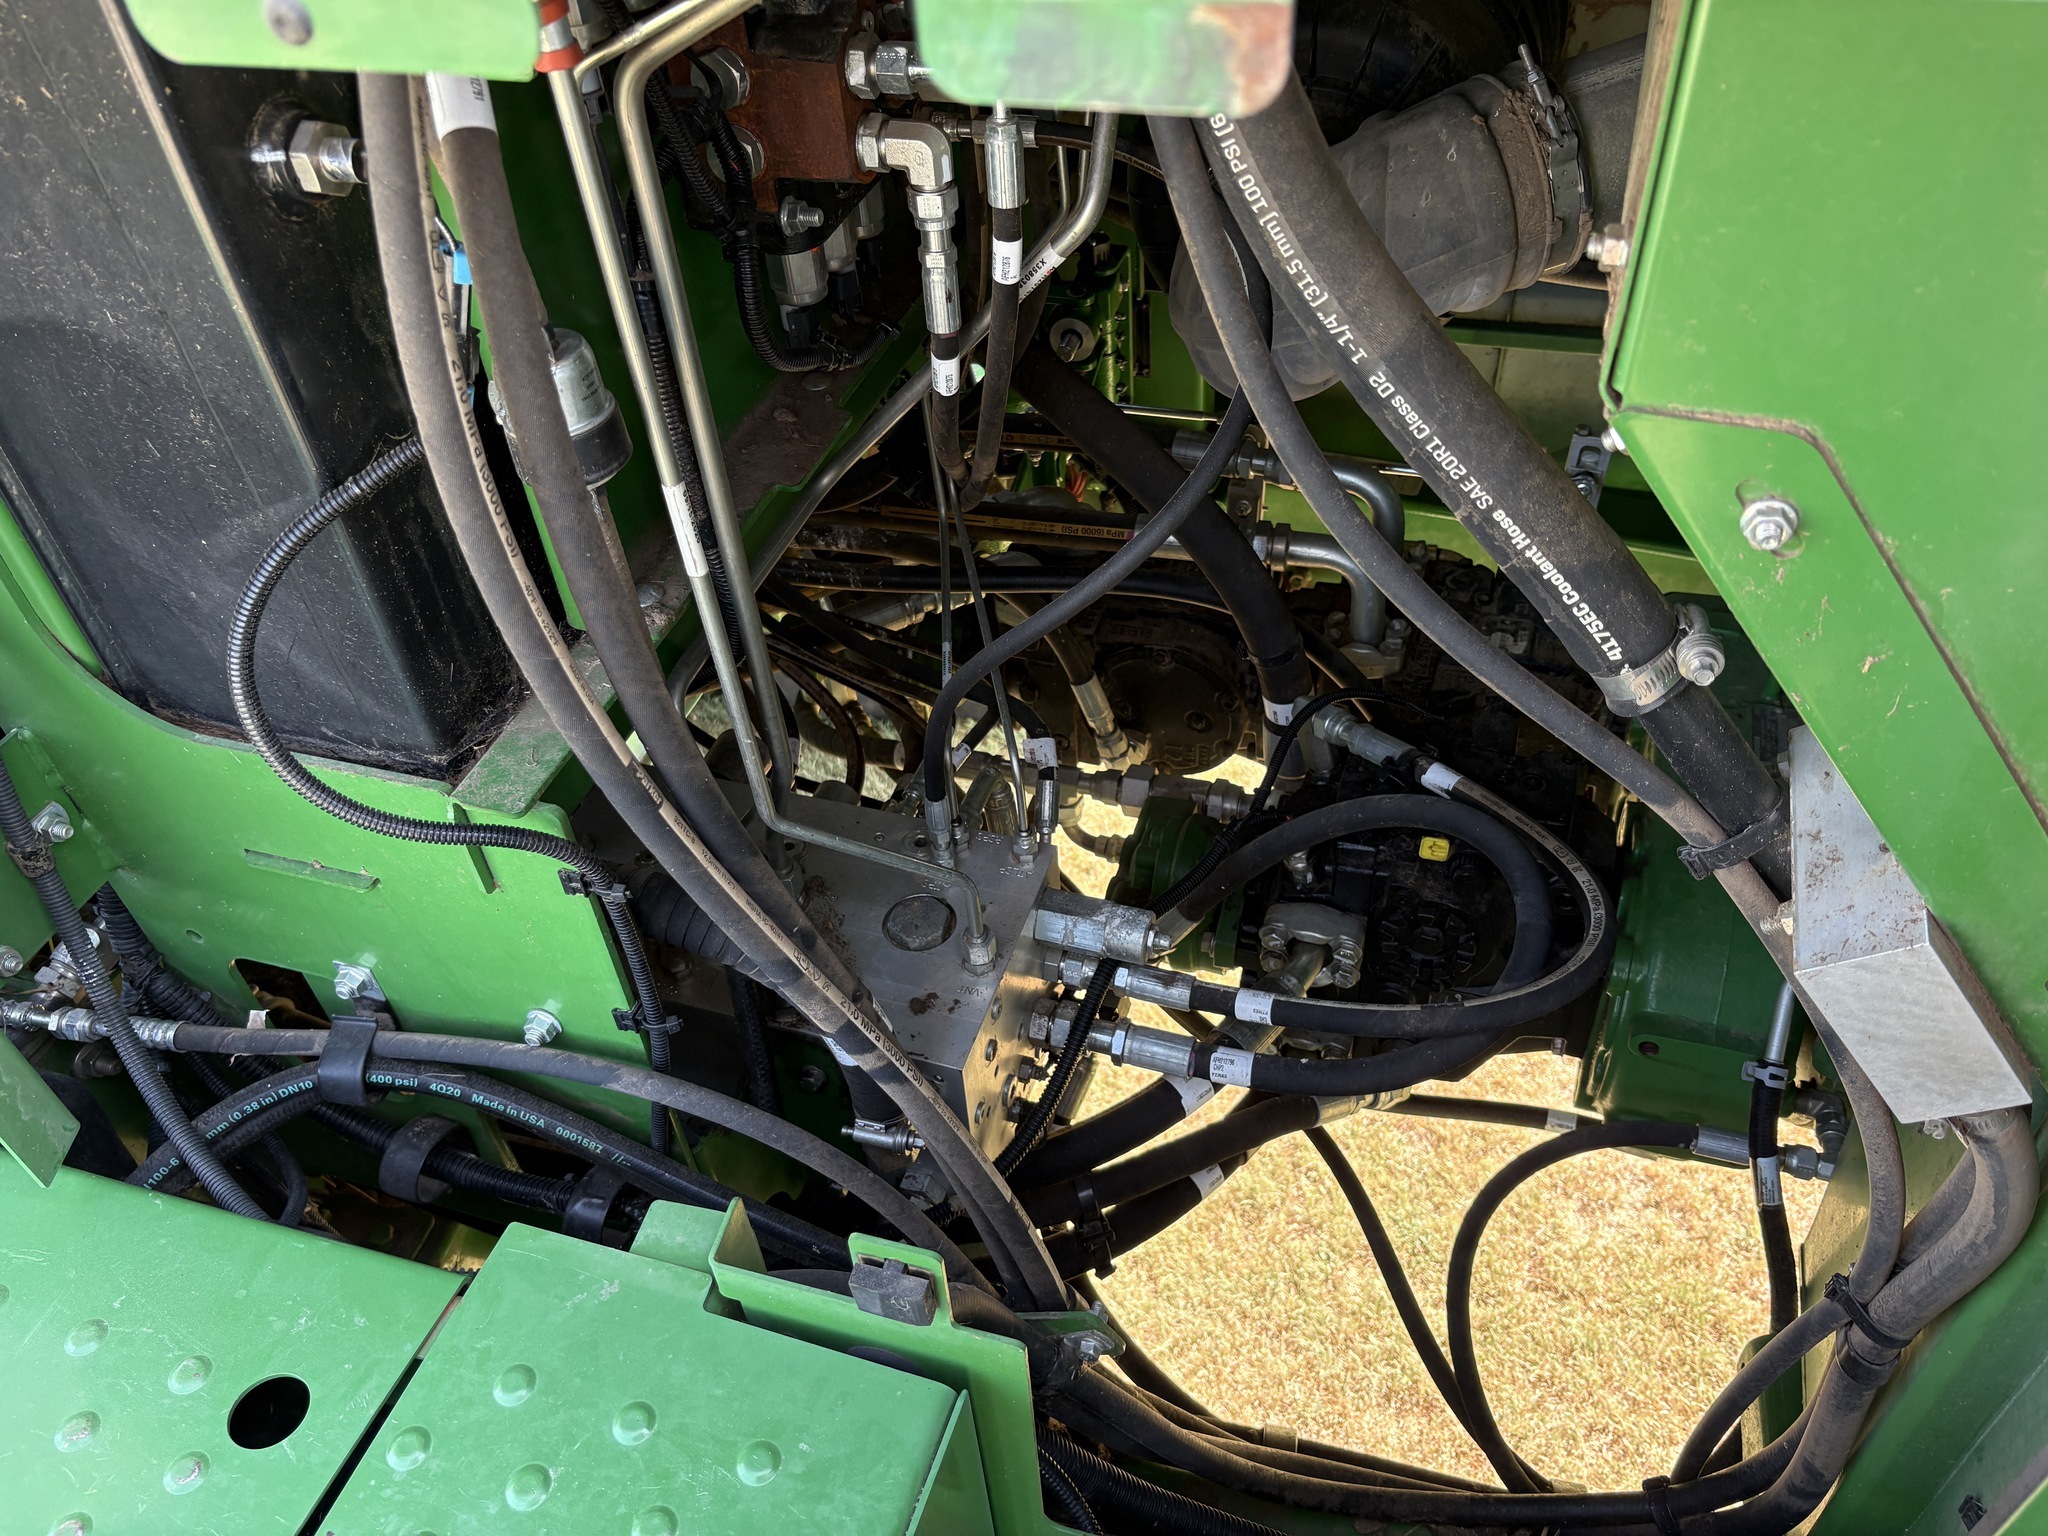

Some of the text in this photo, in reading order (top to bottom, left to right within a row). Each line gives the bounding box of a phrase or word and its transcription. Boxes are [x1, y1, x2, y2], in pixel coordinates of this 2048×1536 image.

[1220, 137, 1248, 174] PSI
[1237, 174, 1268, 215] 100
[1368, 371, 1624, 662] 4175EC Coolant Hose SAE 20R1 Class D2
[1589, 894, 1602, 912] MPa
[860, 1015, 882, 1043] MPa
[205, 1121, 230, 1140] mm
[228, 1100, 261, 1124] (0.38
[259, 1092, 278, 1108] in)
[278, 1079, 314, 1098] DN10
[365, 1073, 393, 1085] (400
[394, 1076, 419, 1088] psi)
[429, 1082, 462, 1098] 4Q20
[471, 1093, 506, 1112] Made
[506, 1104, 518, 1117] in
[519, 1109, 546, 1129] USA
